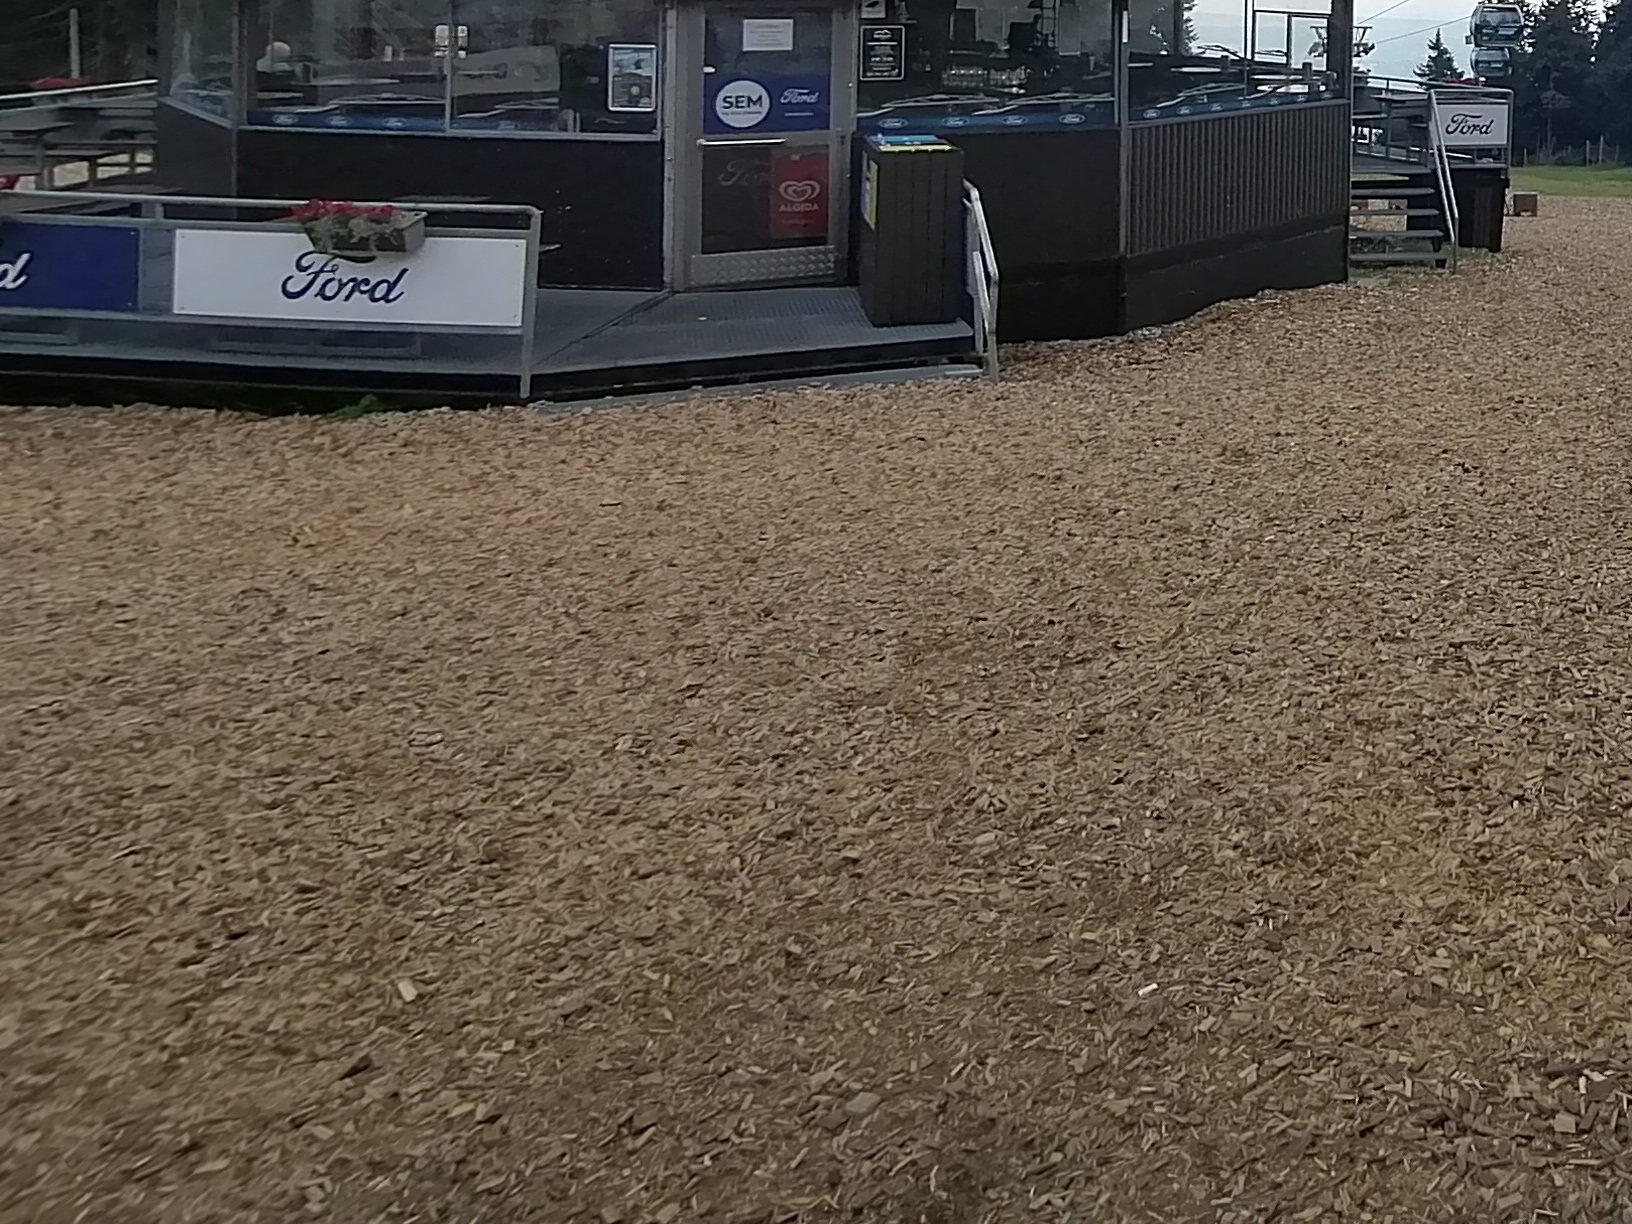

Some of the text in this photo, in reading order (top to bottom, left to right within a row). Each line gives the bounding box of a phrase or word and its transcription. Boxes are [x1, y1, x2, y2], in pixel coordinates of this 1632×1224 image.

[722, 95, 763, 110] SEM
[780, 88, 820, 104] Ford
[1445, 113, 1495, 135] Ford
[778, 202, 820, 213] ALGIDA
[281, 250, 409, 304] Ford
